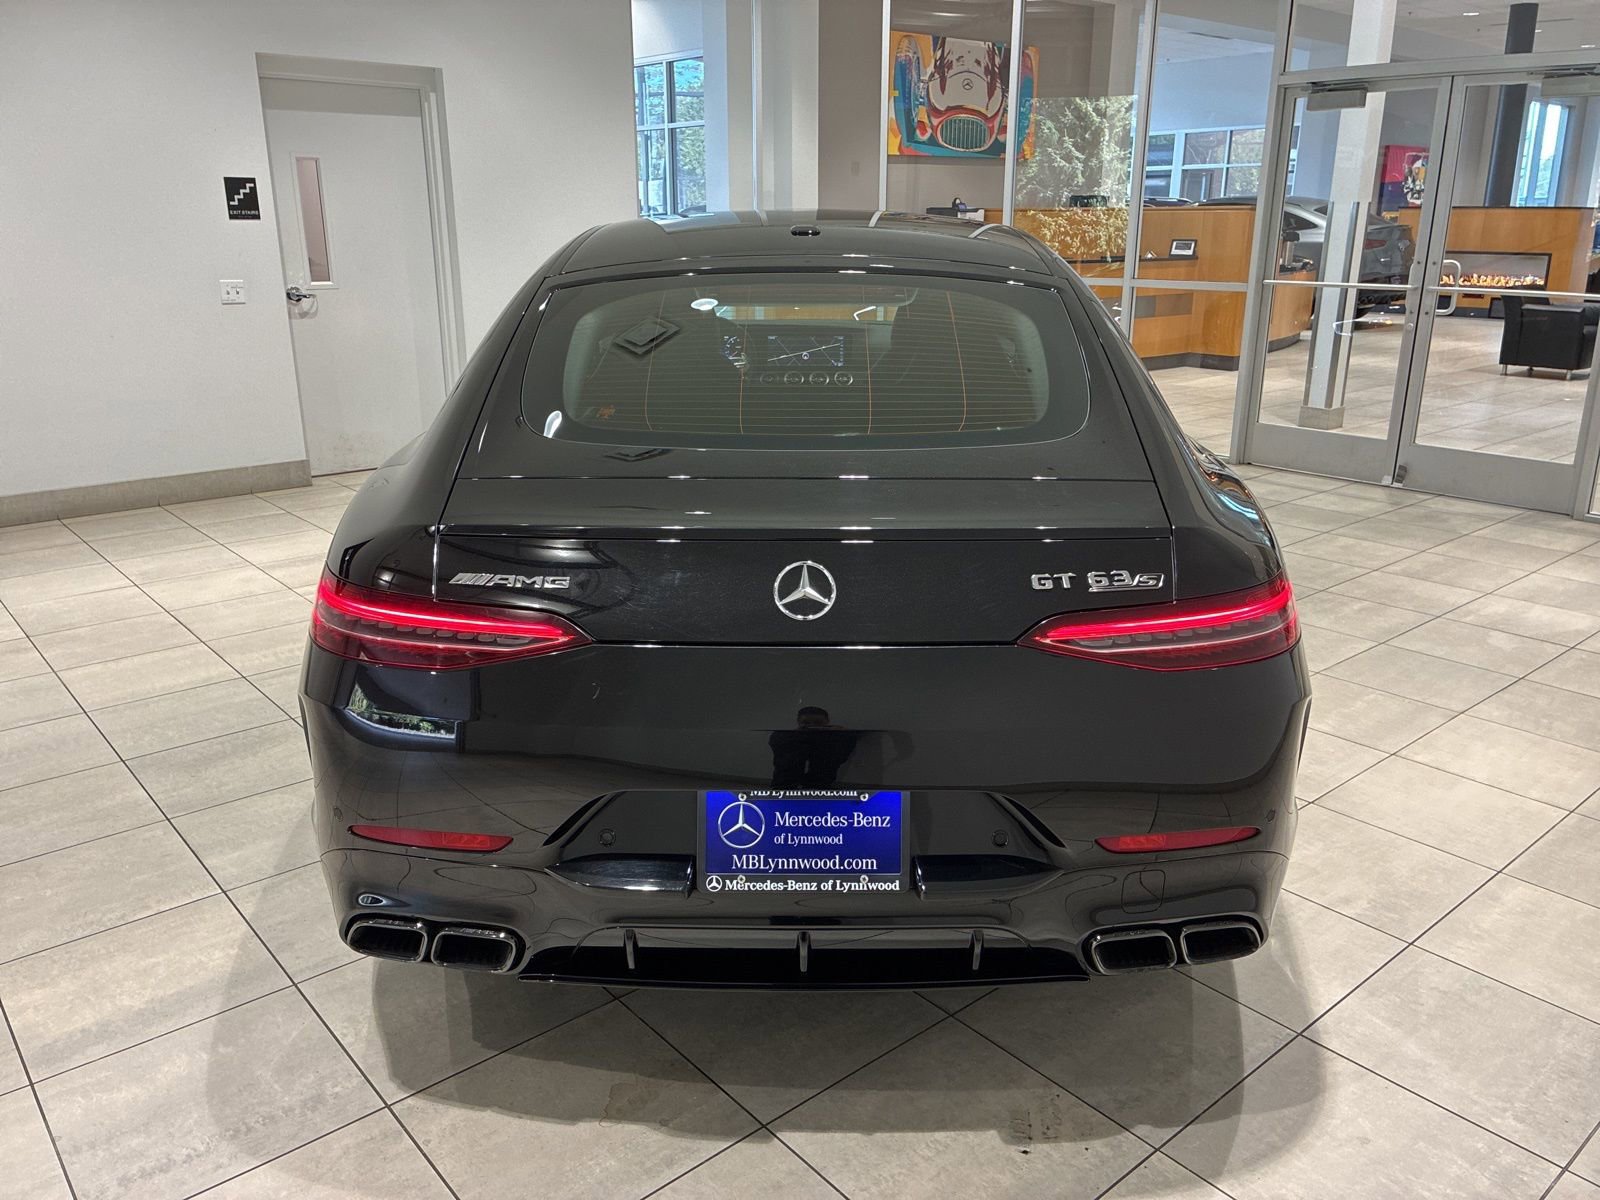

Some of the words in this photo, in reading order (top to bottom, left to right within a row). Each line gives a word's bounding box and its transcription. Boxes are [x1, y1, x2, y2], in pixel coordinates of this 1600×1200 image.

[483, 573, 571, 589] AMG
[1030, 572, 1077, 590] GT
[774, 812, 891, 827] Mercedes-Benz
[774, 833, 785, 845] of
[787, 833, 843, 847] Lynnwood
[731, 854, 878, 873] MBLynnwood.com
[725, 879, 818, 891] Mercedes-Benz
[821, 880, 833, 891] of
[836, 880, 900, 893] Lynnwood
